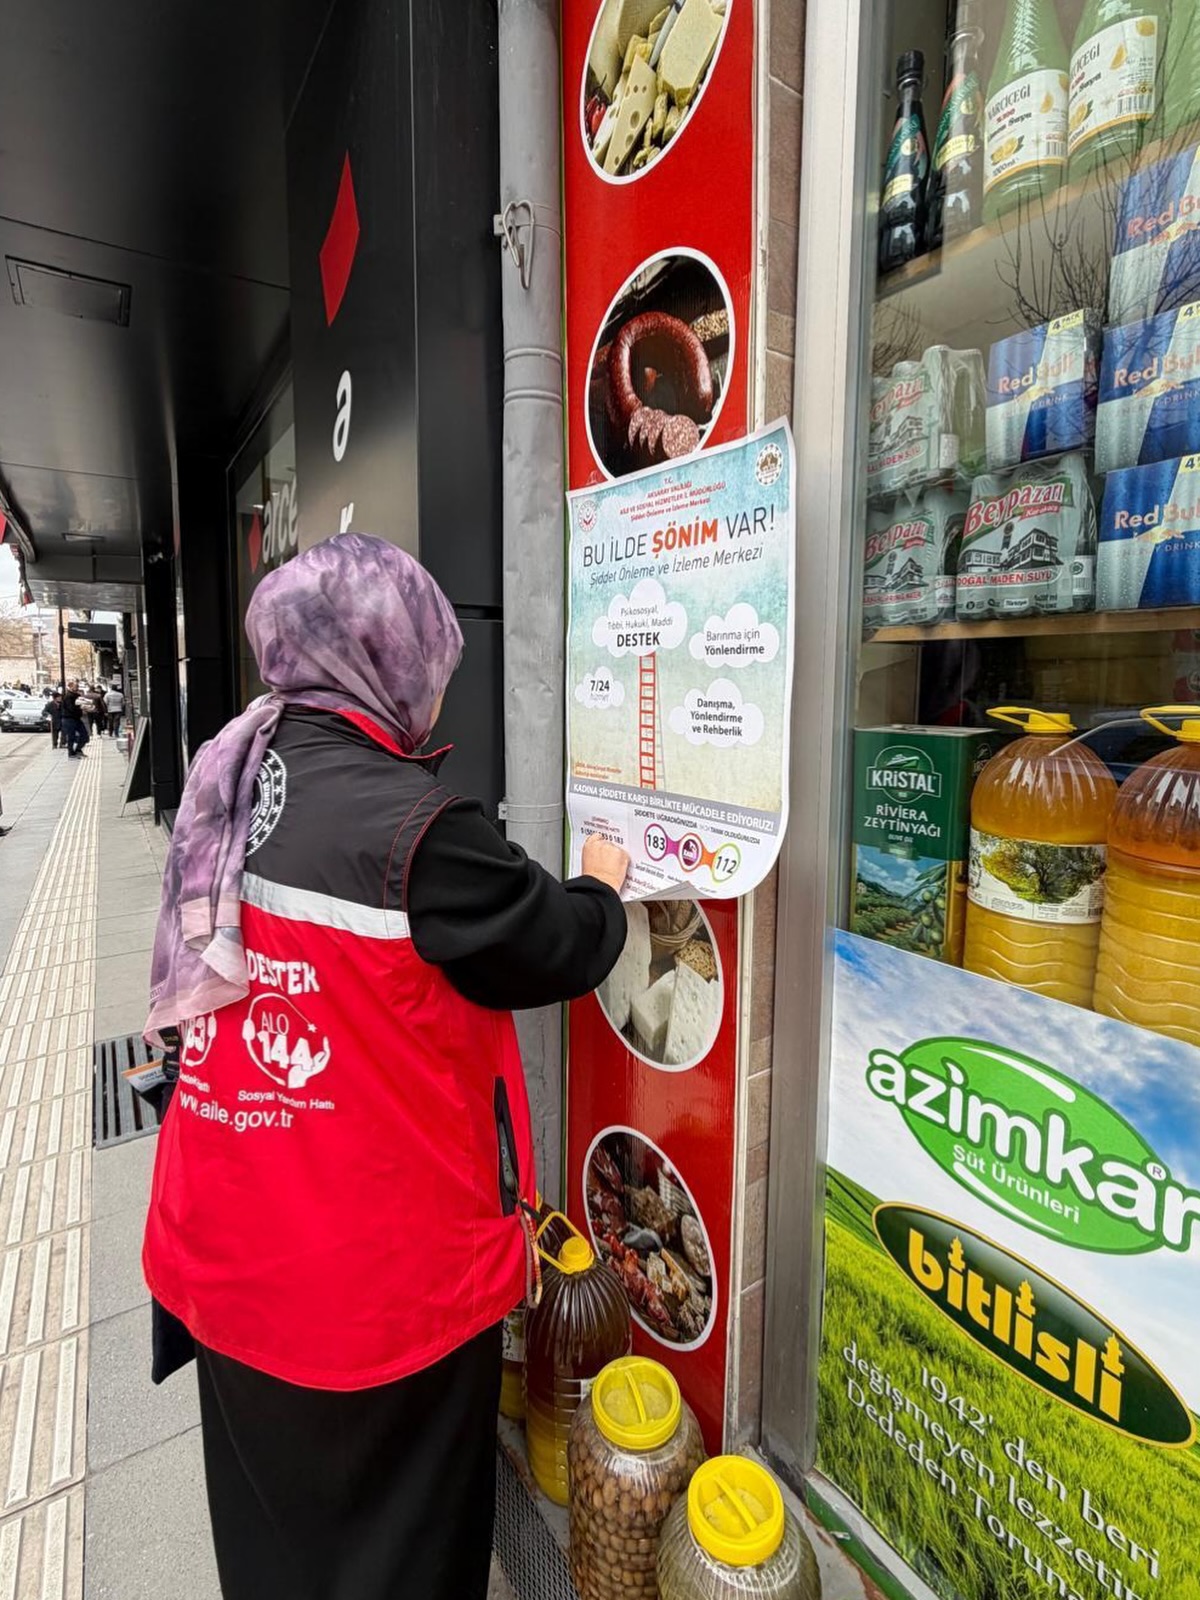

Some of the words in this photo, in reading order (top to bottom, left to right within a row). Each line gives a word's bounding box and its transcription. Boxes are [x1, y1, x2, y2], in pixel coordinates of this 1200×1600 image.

[1128, 201, 1174, 239] Red
[1183, 305, 1194, 318] 4
[1052, 320, 1061, 330] 4
[998, 366, 1034, 394] Red
[1037, 351, 1075, 380] Bull
[1114, 358, 1158, 389] Red
[1164, 345, 1200, 373] Bul
[1184, 457, 1195, 469] 4
[1114, 504, 1160, 531] Red
[1163, 498, 1200, 523] Bul
[583, 542, 605, 568] BU
[609, 533, 648, 563] İLDE
[652, 515, 718, 560] ŞÖNİM
[726, 503, 775, 540] VAR!
[590, 566, 617, 588] Şiddet
[619, 561, 655, 583] Önleme
[658, 563, 670, 576] ve
[672, 554, 709, 574] İzleme
[713, 542, 764, 568] Merkezi
[620, 604, 660, 617] Psikososyal,
[617, 631, 660, 647] DESTEK
[706, 630, 742, 642] Barınma
[744, 628, 760, 642] için
[705, 643, 765, 656] Yönlendirme
[590, 679, 610, 691] 7/24
[697, 698, 735, 711] Danışma,
[690, 710, 743, 724] Yönlendirme
[692, 726, 701, 735] ve
[703, 724, 743, 737] Rehberlik
[573, 783, 598, 795] KADINA
[599, 786, 626, 801] ŞİDDETE
[627, 791, 649, 806] KARŞI
[649, 795, 682, 812] BİRLİKTE
[682, 801, 726, 821] MÜCADELE
[727, 809, 774, 832] EDİYORUZ!
[876, 803, 928, 821] RİVİERA
[864, 816, 941, 838] ZEYTİNYAĞI
[646, 834, 666, 851] 183
[715, 856, 737, 874] 112
[246, 948, 320, 995] DESTEK
[184, 1015, 206, 1052] 83
[261, 1010, 289, 1036] ALO
[257, 1030, 315, 1072] 144
[238, 1090, 275, 1104] Sosyal
[309, 1098, 335, 1111] Hattı
[952, 1144, 987, 1176] Süt
[991, 1160, 1081, 1226] Ürünleri
[908, 1227, 1125, 1423] bitlisli
[843, 1340, 995, 1487] değişmeyen
[846, 1378, 958, 1497] Dededen
[1004, 1436, 1068, 1502] den
[1081, 1486, 1160, 1579] beri
